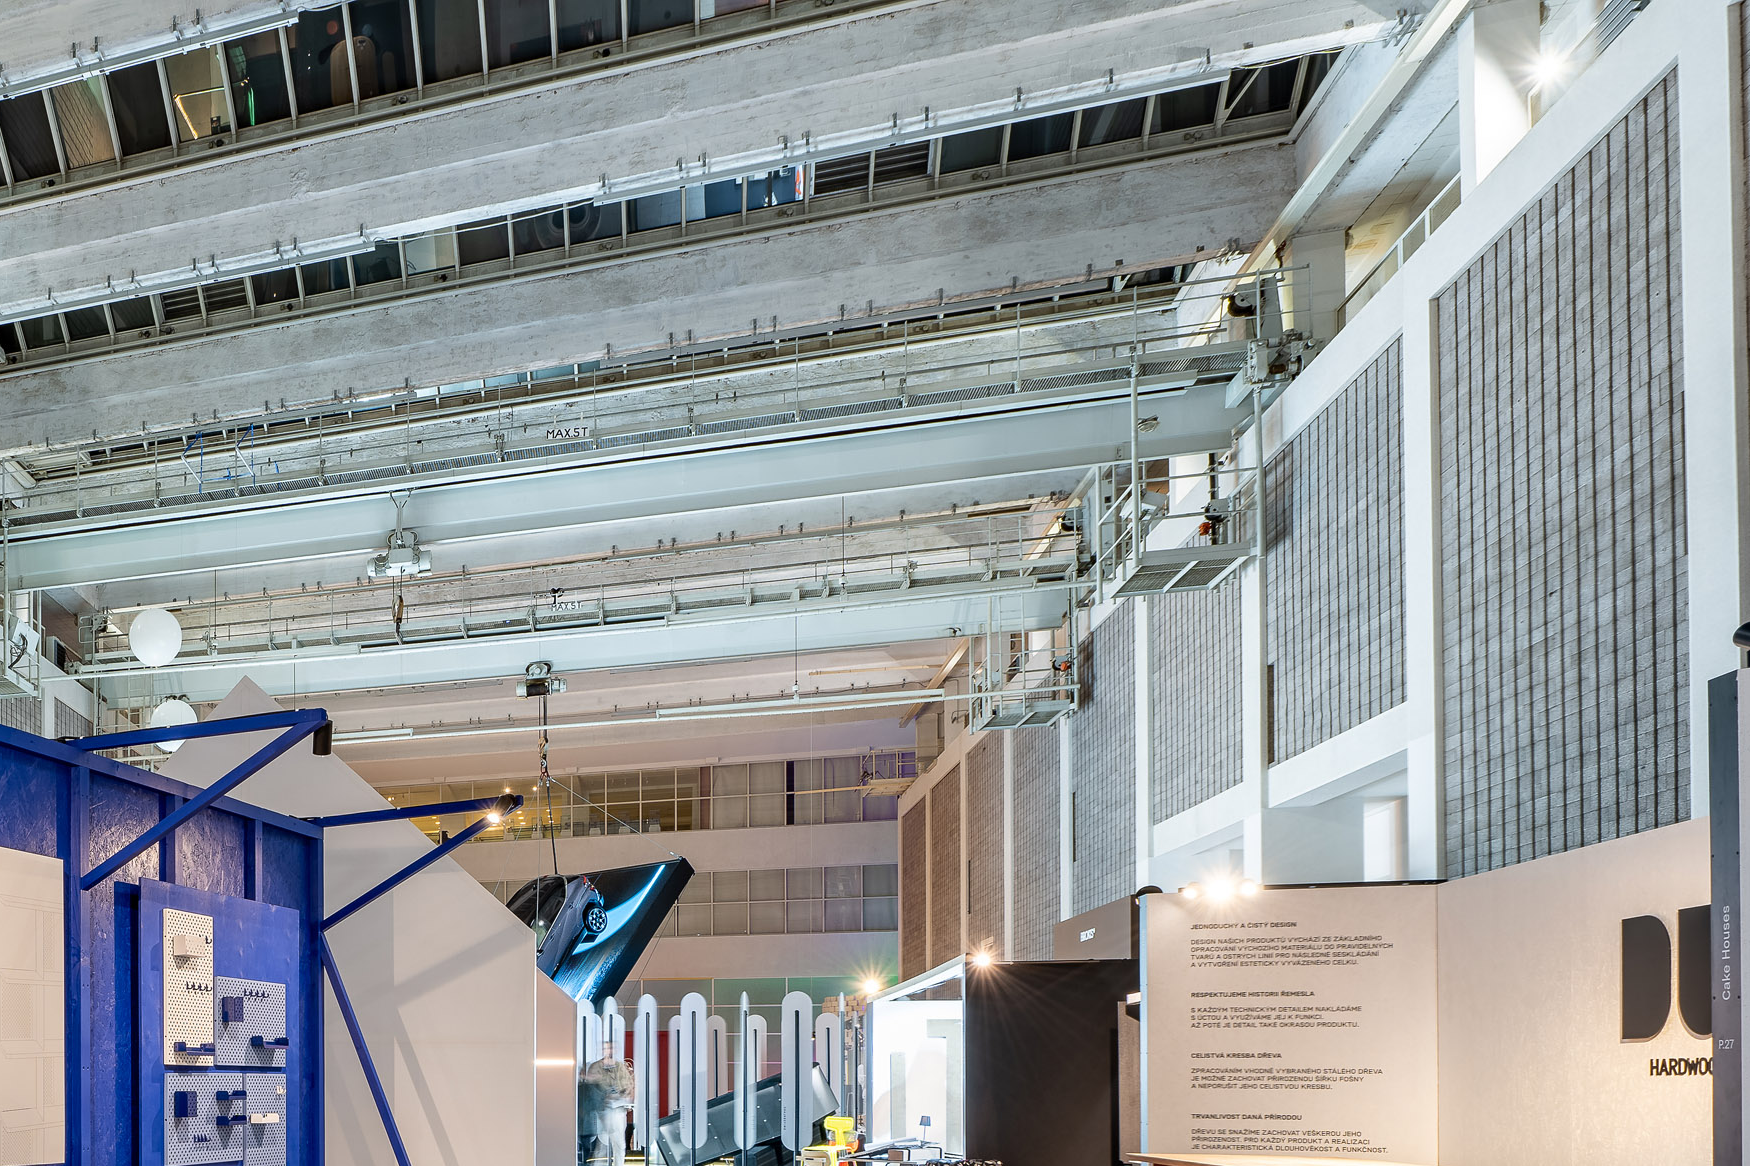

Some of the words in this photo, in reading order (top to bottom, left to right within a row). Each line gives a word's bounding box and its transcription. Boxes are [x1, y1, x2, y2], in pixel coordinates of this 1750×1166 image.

[1722, 905, 1730, 960] Houses
[1722, 964, 1730, 1001] Cake
[1718, 1039, 1734, 1050] P.27
